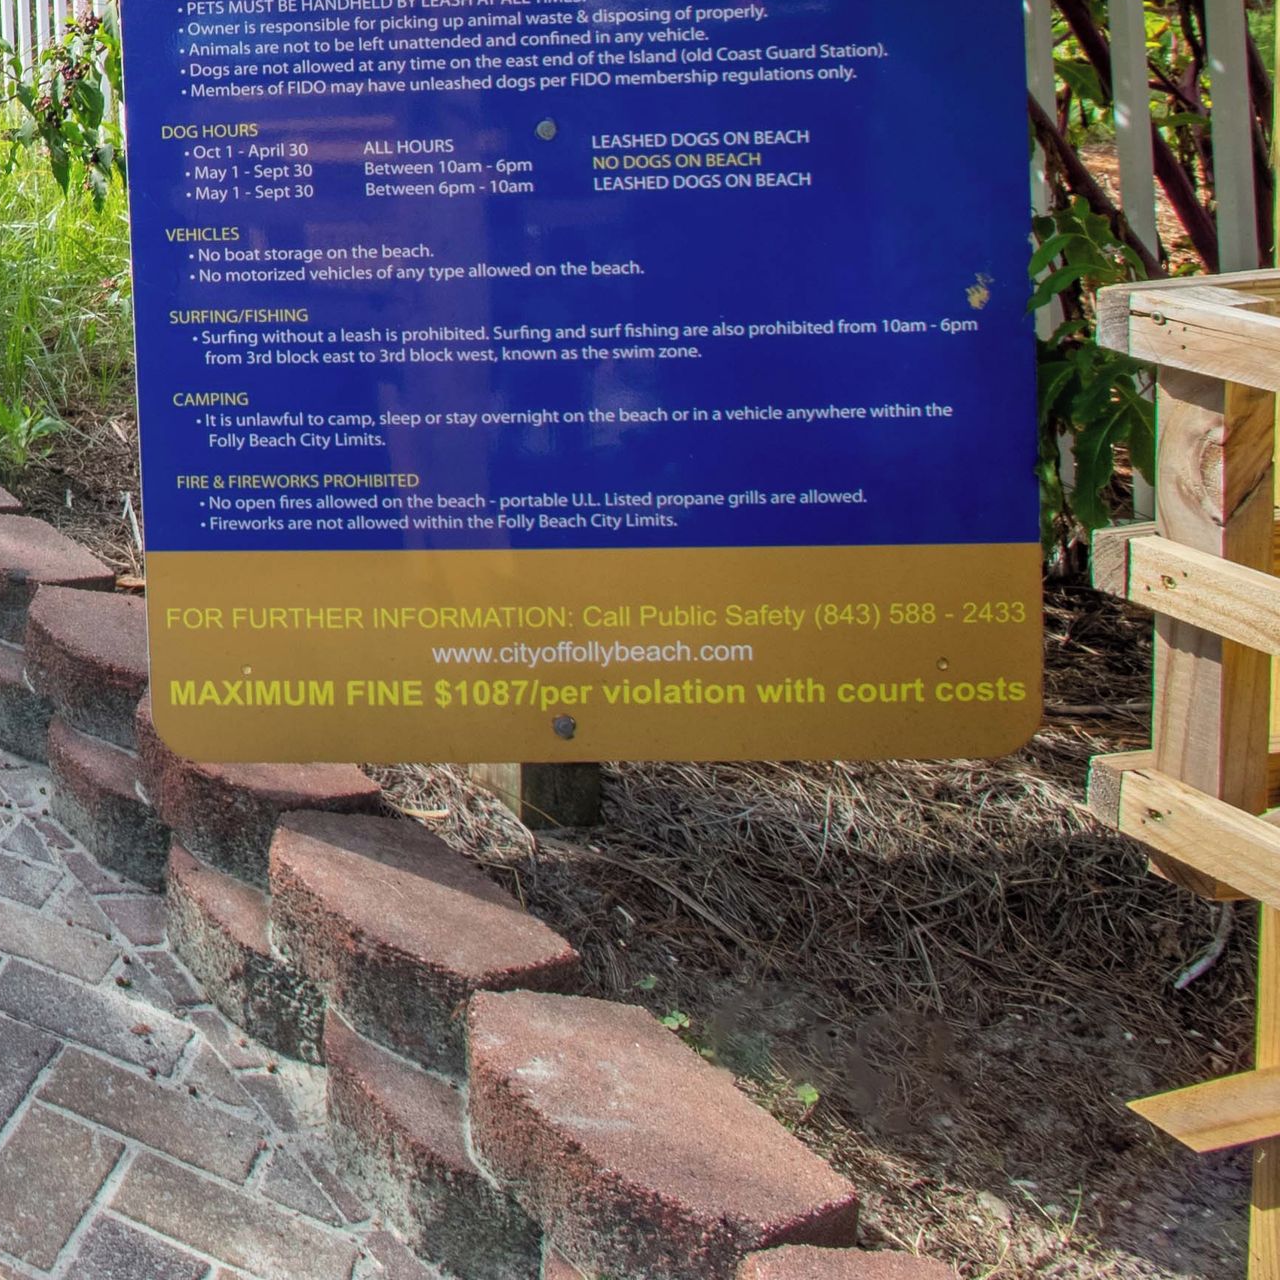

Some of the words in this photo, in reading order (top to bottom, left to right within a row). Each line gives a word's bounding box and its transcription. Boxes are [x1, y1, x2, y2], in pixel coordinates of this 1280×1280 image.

[187, 0, 224, 15] PETS
[228, 0, 274, 13] MUST
[161, 124, 198, 139] DOG
[202, 122, 260, 138] HOURS
[591, 133, 667, 149] LEASHED
[670, 131, 720, 147] DOGS
[722, 131, 750, 146] ON
[753, 129, 810, 145] BEACH
[363, 140, 393, 155] ALL
[396, 138, 454, 154] HOURS
[592, 155, 620, 170] NO
[622, 153, 672, 169] DOGS
[674, 153, 702, 168] ON
[705, 151, 761, 167] BEACH
[593, 175, 669, 191] LEASHED
[673, 173, 721, 189] DOGS
[724, 173, 752, 188] ON
[755, 171, 811, 187] BEACH
[164, 226, 239, 242] VEHICLES
[198, 247, 220, 262] No
[224, 247, 260, 261] boat
[263, 248, 323, 263] storage
[326, 248, 347, 259] on
[351, 244, 378, 259] the
[381, 243, 434, 258] beach.
[169, 308, 308, 324] SURFING/FISHING
[172, 391, 249, 407] CAMPING
[209, 433, 245, 450] Folly
[249, 432, 296, 447] Beach
[300, 432, 330, 449] City
[335, 432, 385, 446] Limits.
[176, 474, 209, 489] FIRE
[212, 474, 224, 489] &
[228, 474, 319, 488] FIREWORKS
[323, 473, 419, 488] PROHIBITED
[209, 515, 284, 530] Fireworks
[287, 518, 313, 530] are
[316, 517, 343, 530] not
[346, 514, 409, 529] allowed
[412, 514, 463, 529] within
[466, 514, 494, 529] the
[497, 513, 535, 531] Folly
[538, 513, 587, 528] Beach
[590, 513, 622, 531] City
[625, 512, 678, 527] Limits.
[166, 607, 224, 629] FOR
[232, 607, 364, 629] FURTHER
[372, 606, 573, 629] INFORMATION:
[582, 604, 630, 627] Call
[639, 604, 717, 626] Public
[724, 603, 806, 631] Safety
[814, 602, 881, 630] (843)
[889, 602, 936, 624] 588
[962, 601, 1026, 623] 2433
[431, 639, 753, 668] www.cityoffollybeach.com
[170, 679, 334, 706] MAXIMUM
[346, 679, 423, 706] FINE
[434, 678, 593, 711] $1087/per
[601, 678, 745, 704] violation
[755, 676, 825, 703] with
[836, 677, 925, 703] court
[934, 676, 1026, 702] costs
